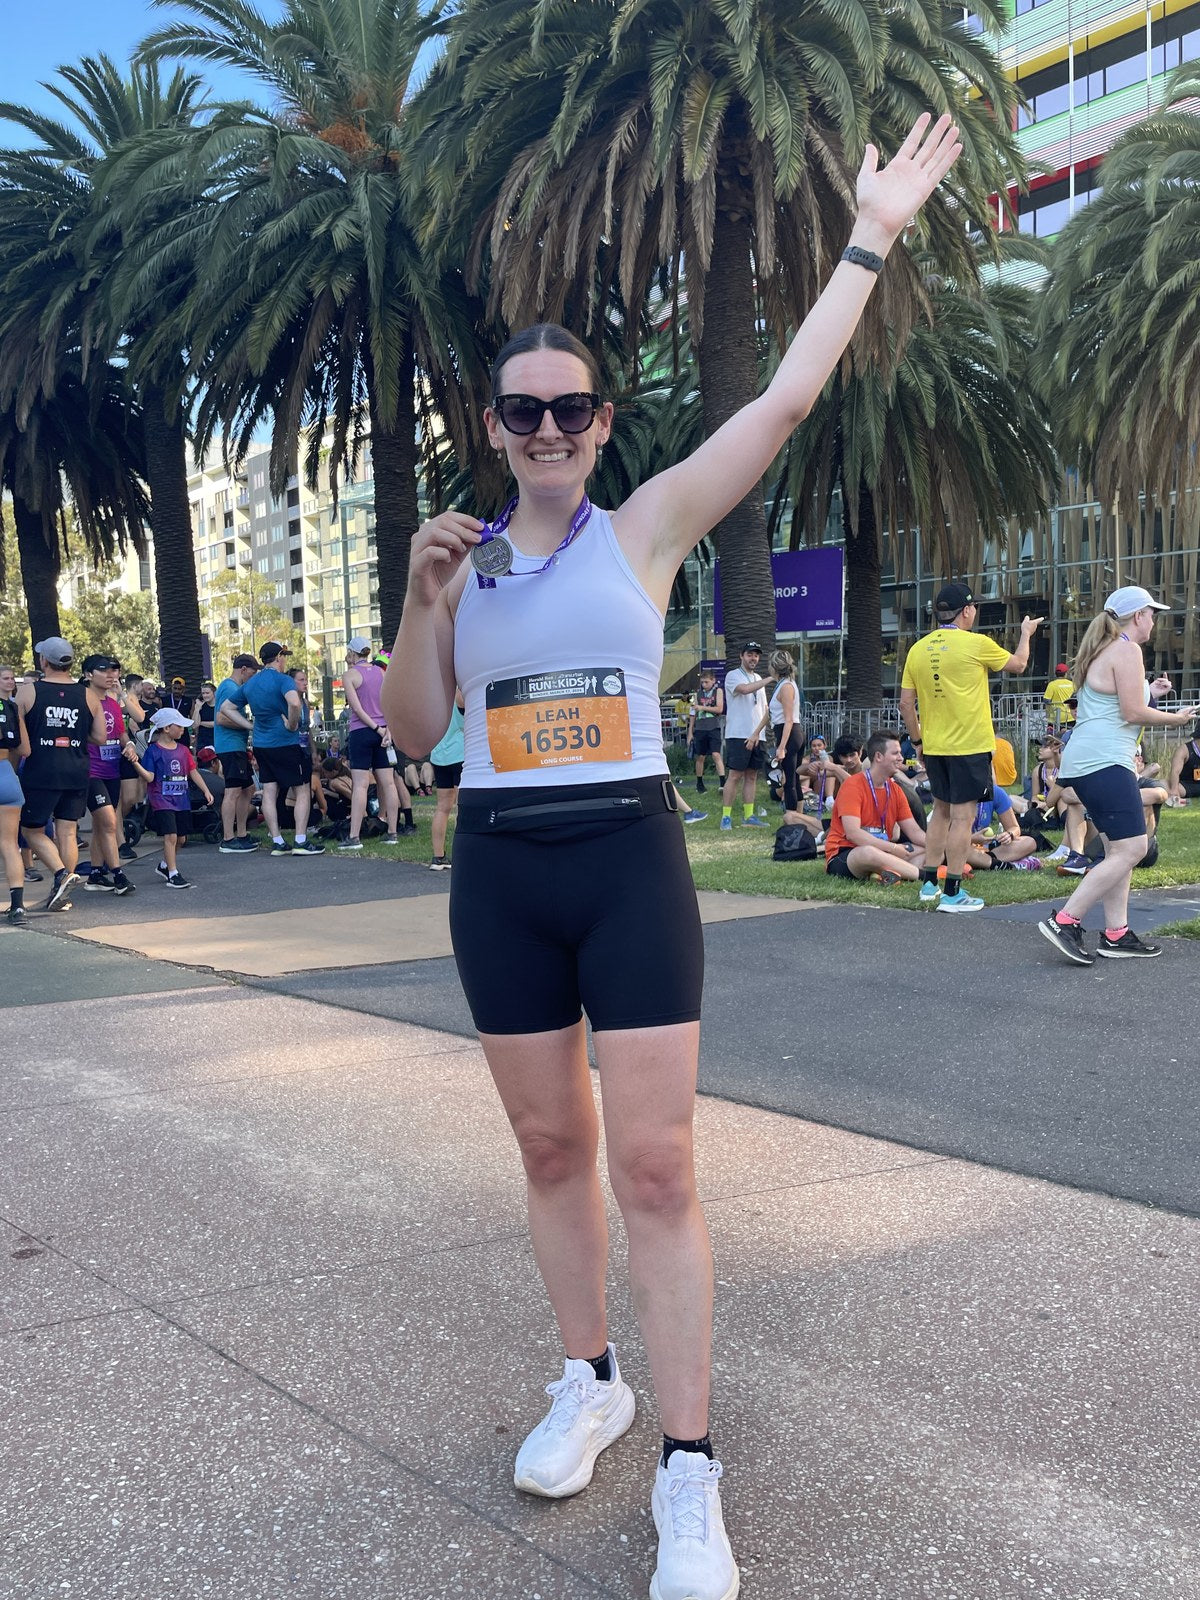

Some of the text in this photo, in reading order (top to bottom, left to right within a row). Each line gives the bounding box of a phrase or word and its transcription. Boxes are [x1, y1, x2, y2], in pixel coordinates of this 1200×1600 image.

[773, 586, 808, 598] ROP 3
[528, 680, 552, 692] RUN
[45, 706, 79, 720] CWRC
[536, 707, 580, 723] LEAH
[520, 724, 601, 755] 16530
[558, 755, 584, 763] COURSE
[1047, 918, 1061, 934] HOKA
